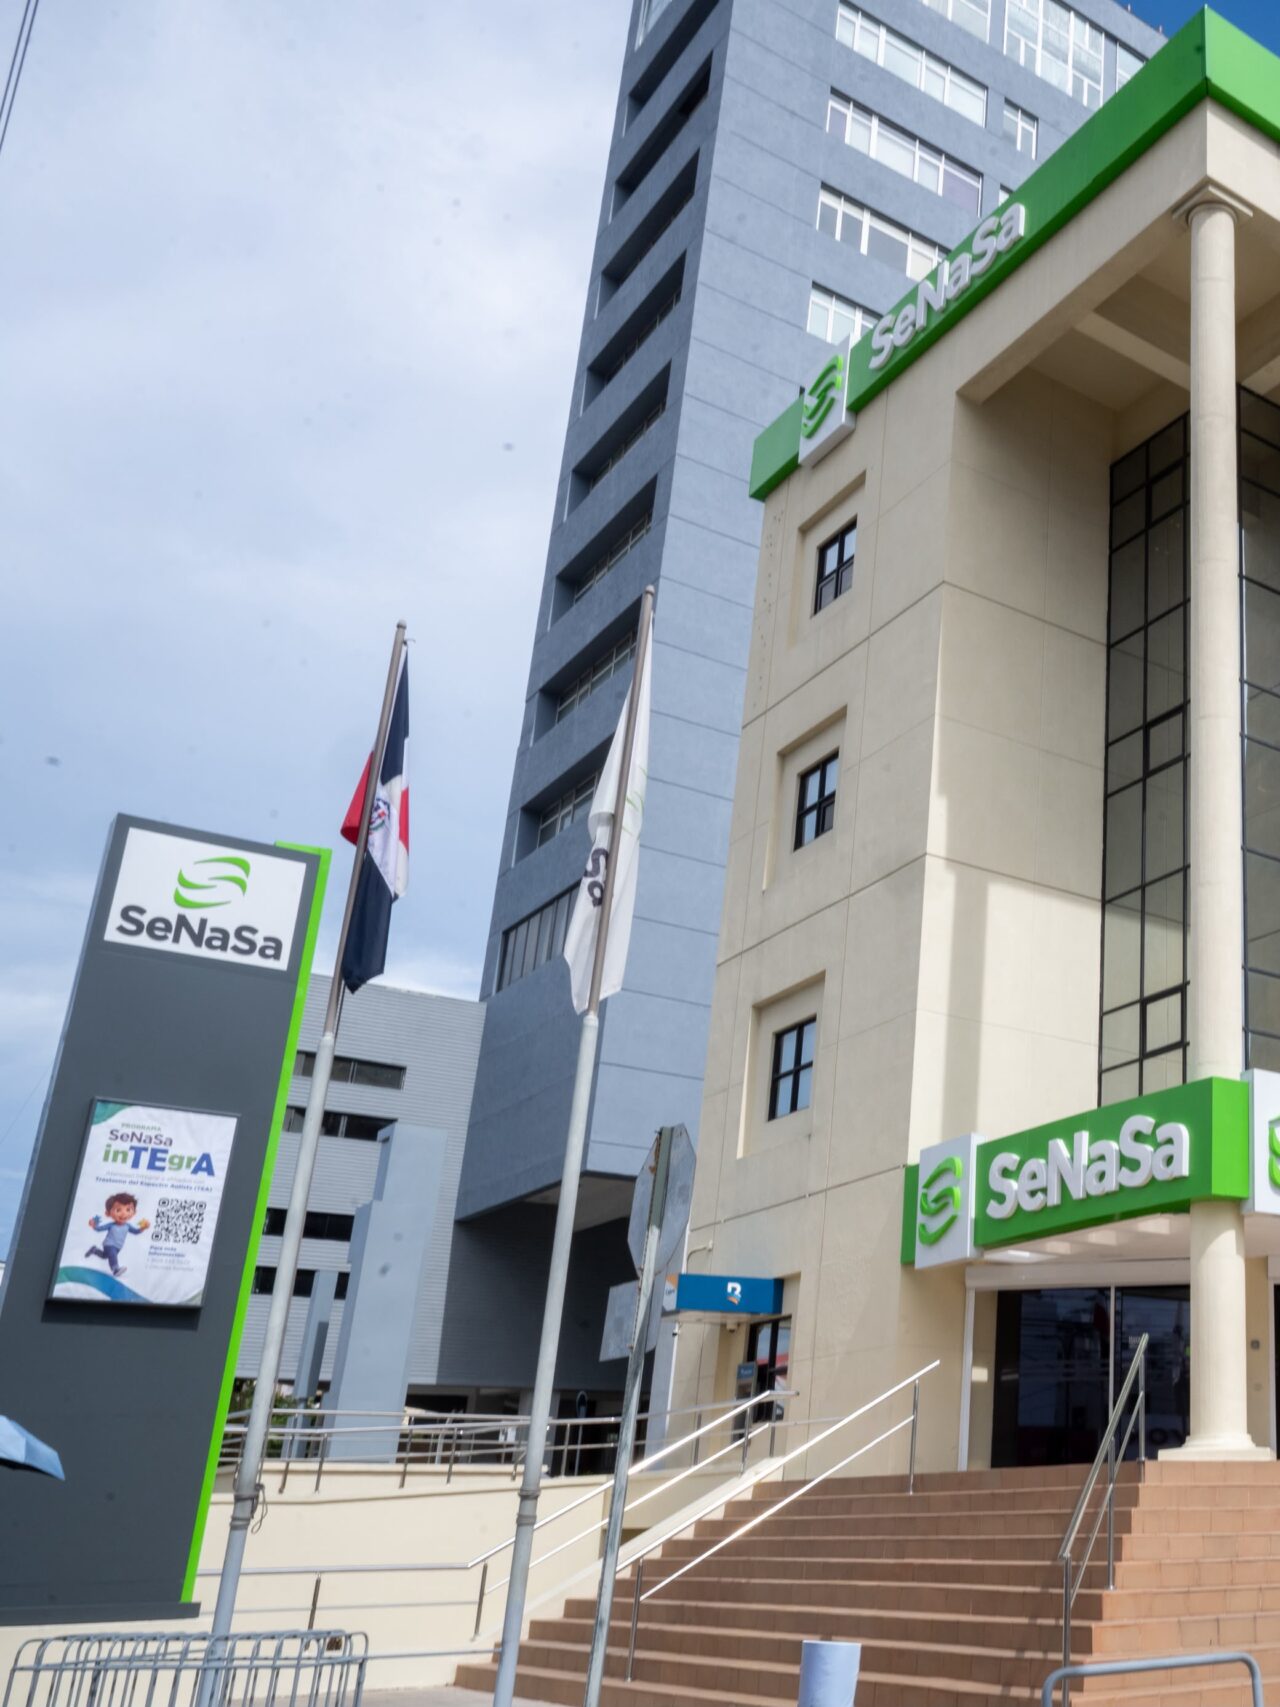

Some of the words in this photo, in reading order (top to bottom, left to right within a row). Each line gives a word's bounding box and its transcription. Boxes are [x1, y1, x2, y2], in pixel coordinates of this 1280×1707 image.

[868, 202, 1026, 370] SeNaSa
[115, 904, 284, 961] SeNaSa
[108, 1129, 173, 1147] SeNaSa
[121, 1123, 162, 1132] PROGRAMA
[102, 1144, 215, 1177] inTEgrA
[986, 1114, 1190, 1220] SeNaSa
